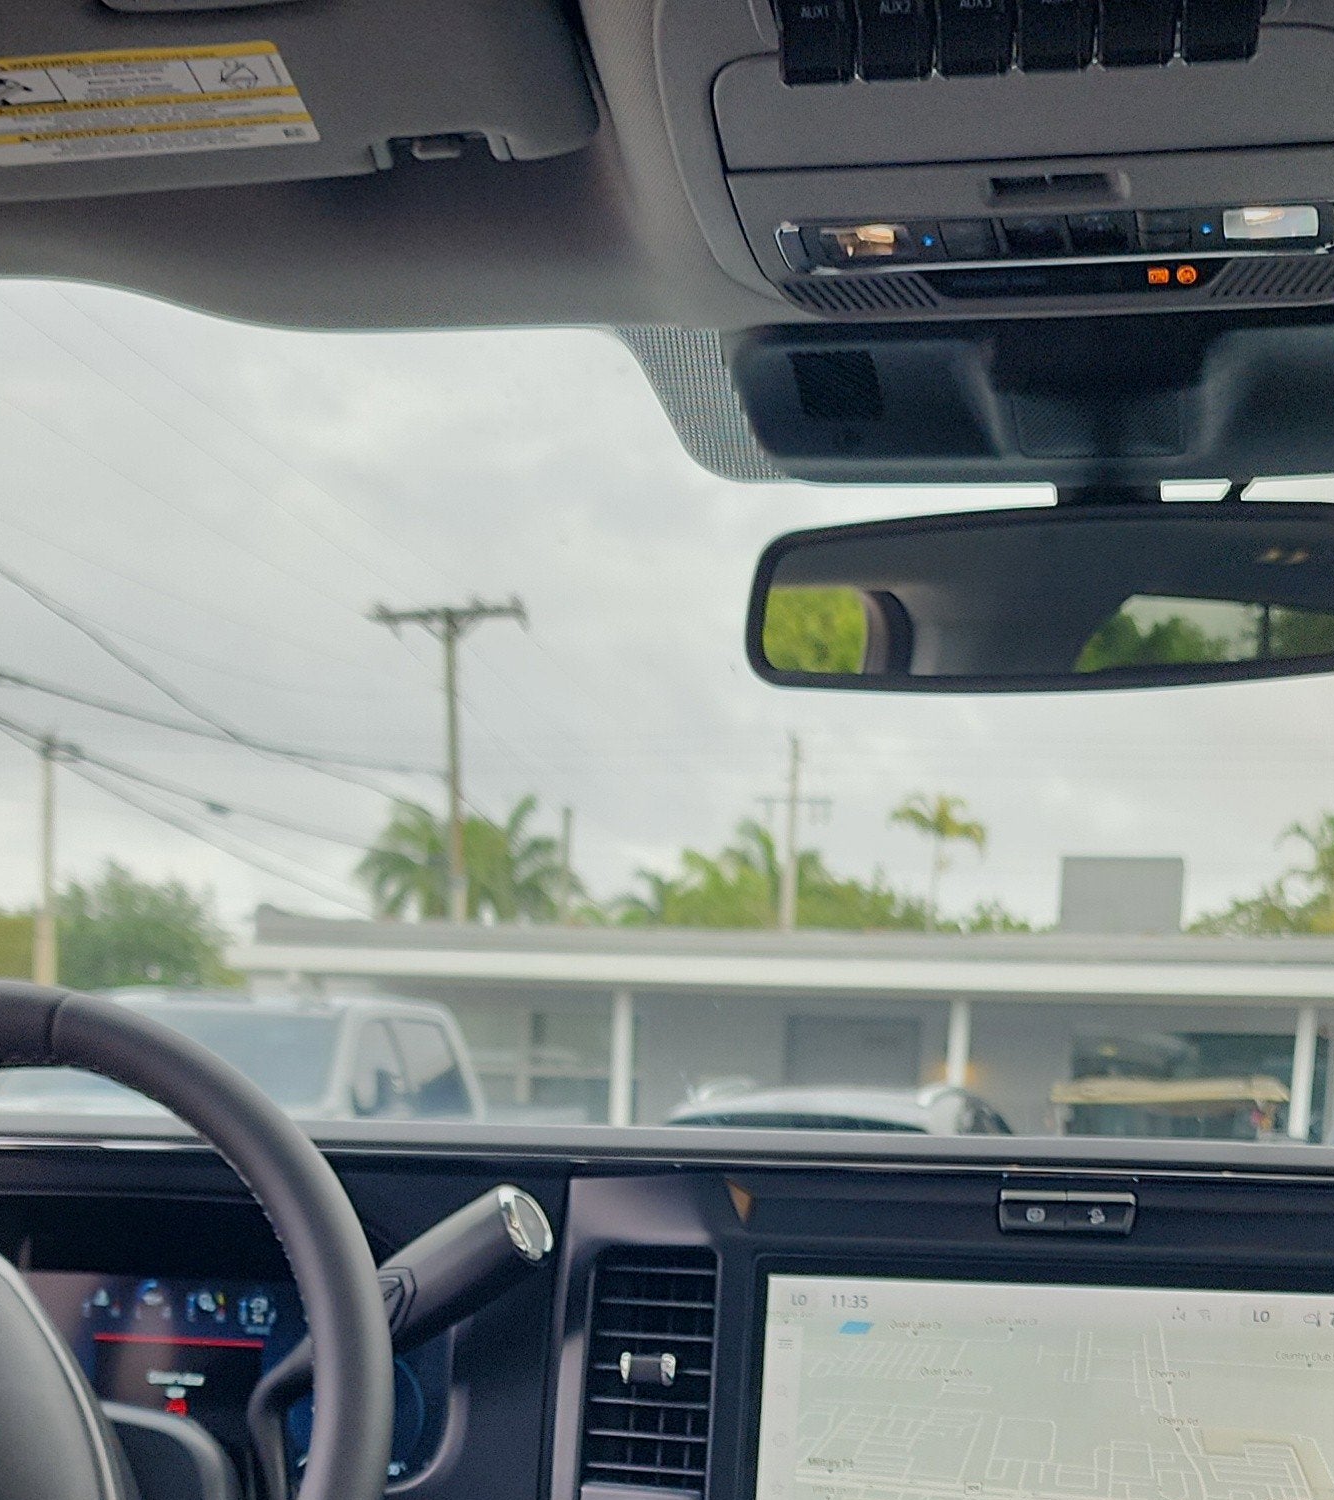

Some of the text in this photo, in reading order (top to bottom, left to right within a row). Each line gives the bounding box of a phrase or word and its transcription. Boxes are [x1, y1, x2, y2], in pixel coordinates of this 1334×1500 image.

[801, 6, 829, 18] AUX1
[879, 0, 911, 14] AUX2
[790, 1294, 808, 1307] LO
[831, 1294, 870, 1310] 11:35
[1252, 1309, 1271, 1323] LO
